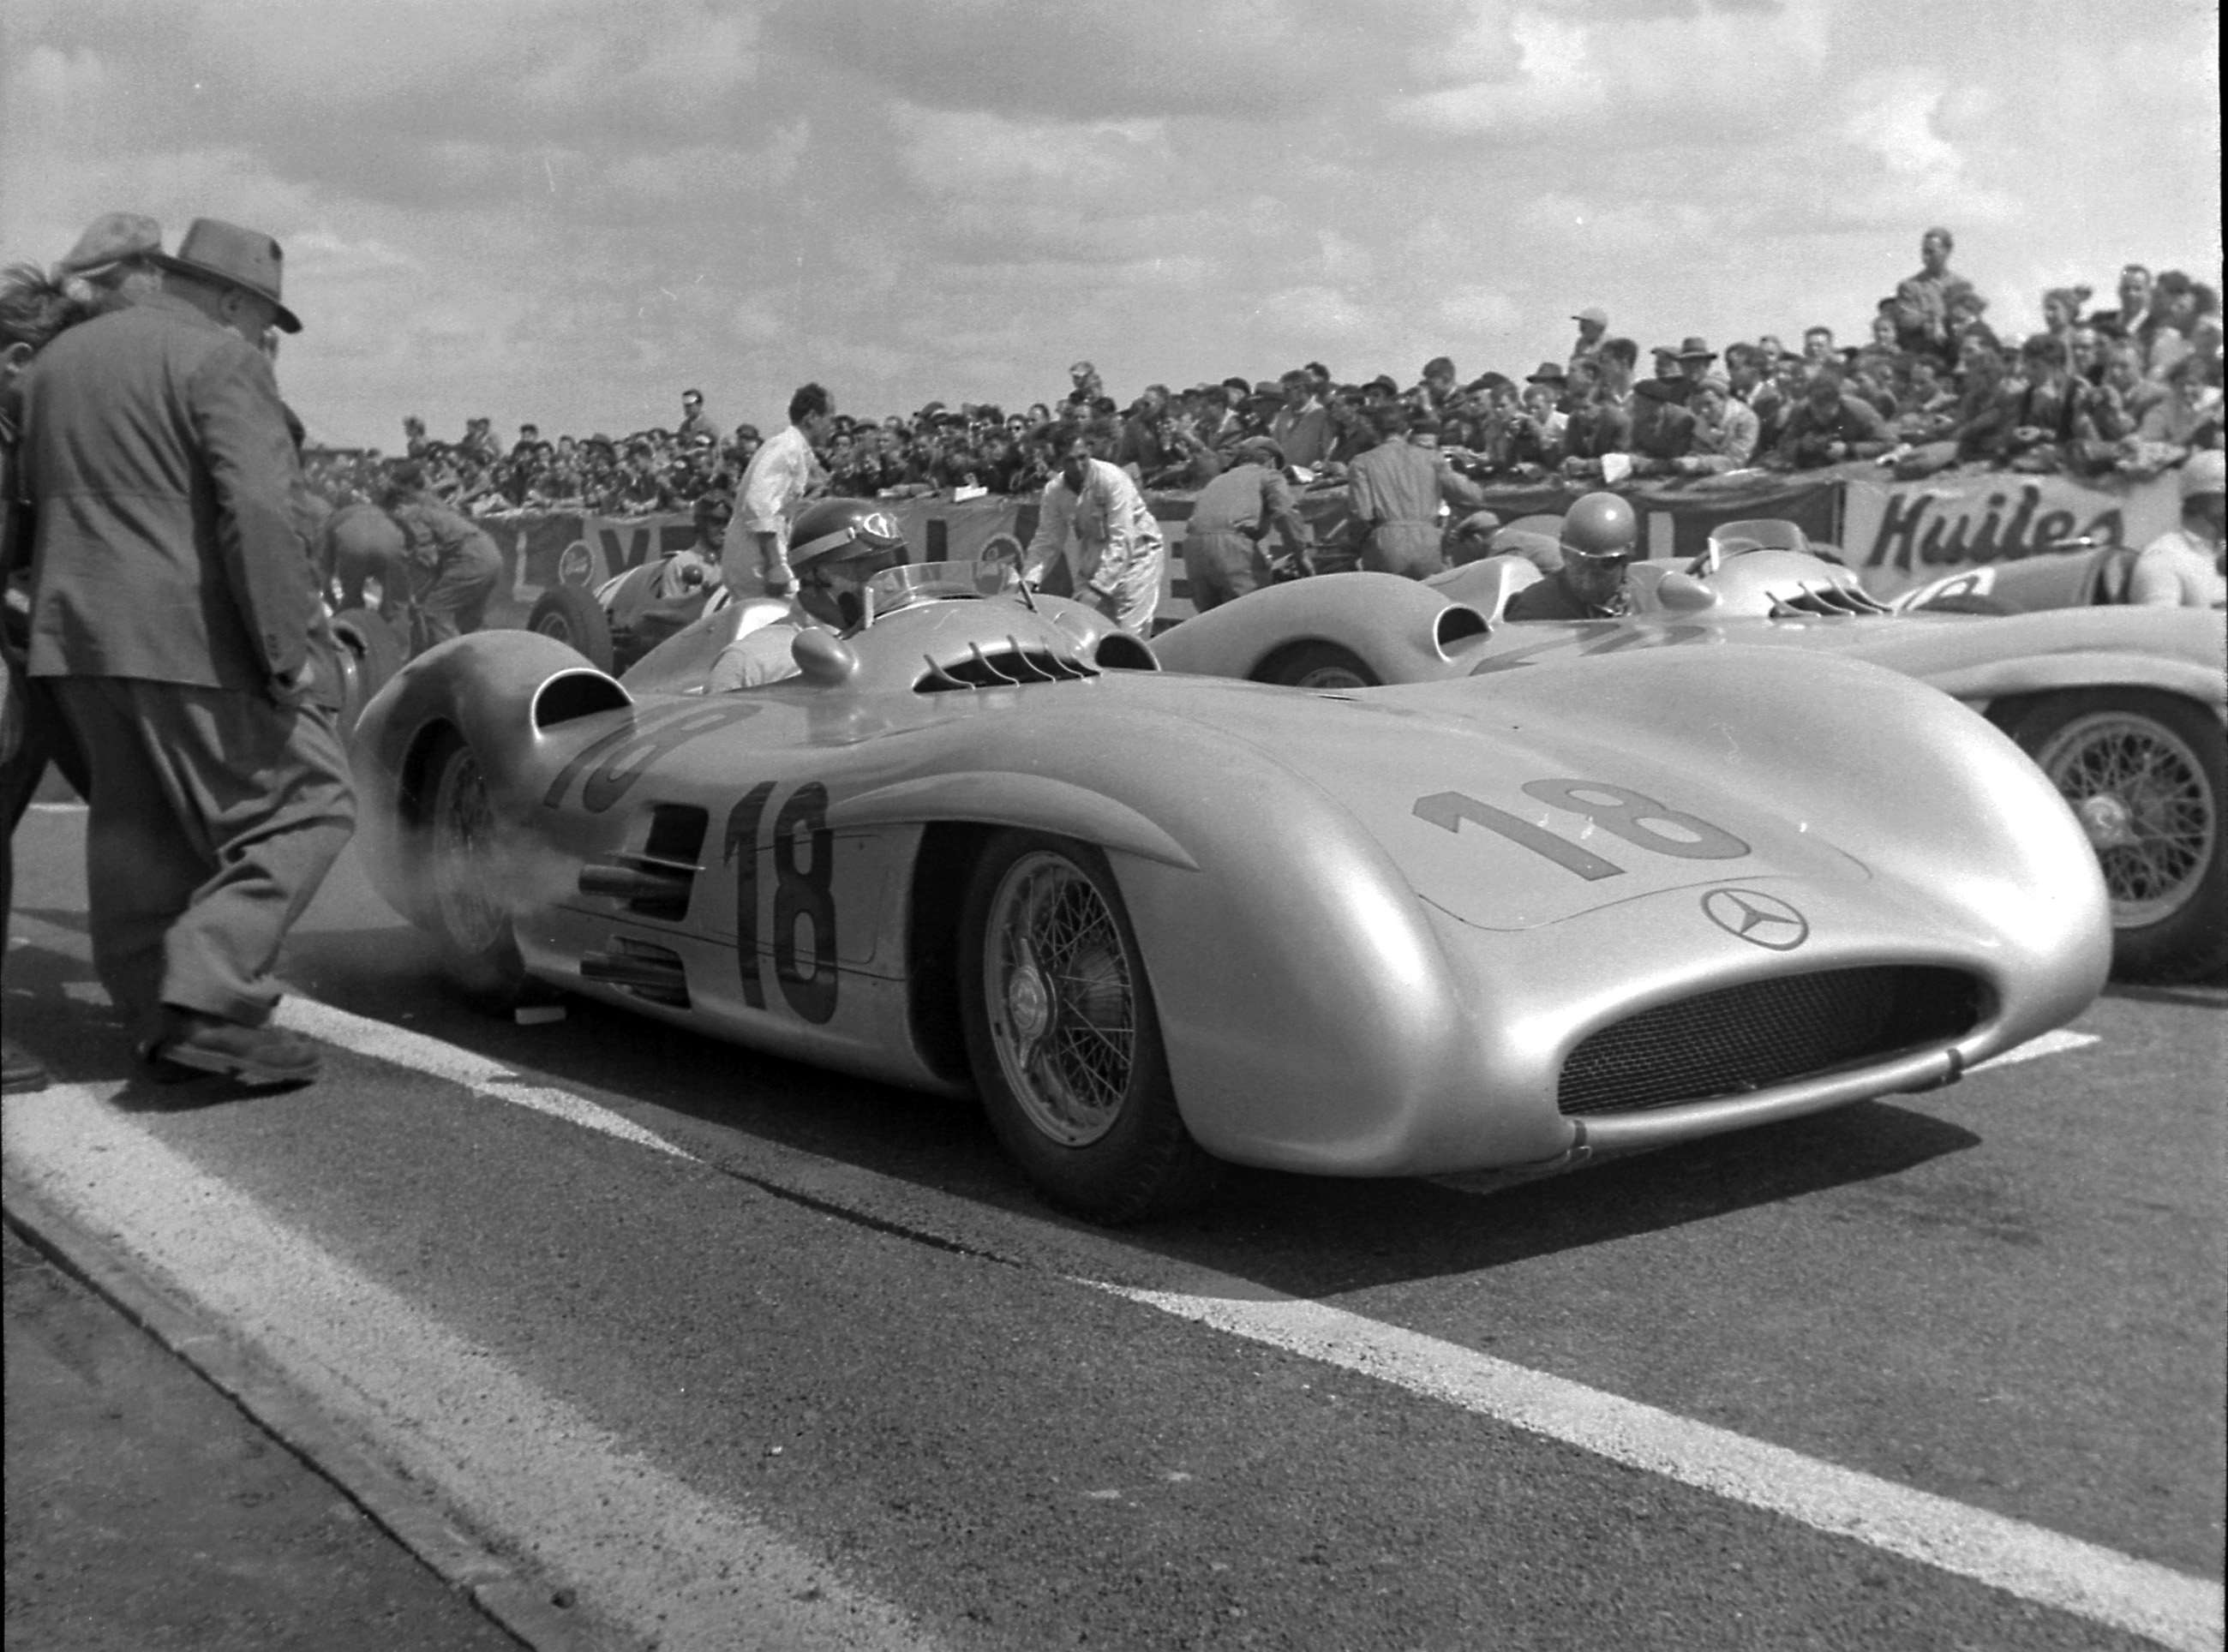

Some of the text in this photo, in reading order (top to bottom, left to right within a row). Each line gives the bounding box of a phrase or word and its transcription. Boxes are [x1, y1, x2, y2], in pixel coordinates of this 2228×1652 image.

[1866, 482, 2125, 572] Huiles
[543, 700, 764, 813] 18
[1412, 778, 1751, 882] 18
[723, 781, 839, 1024] 18
